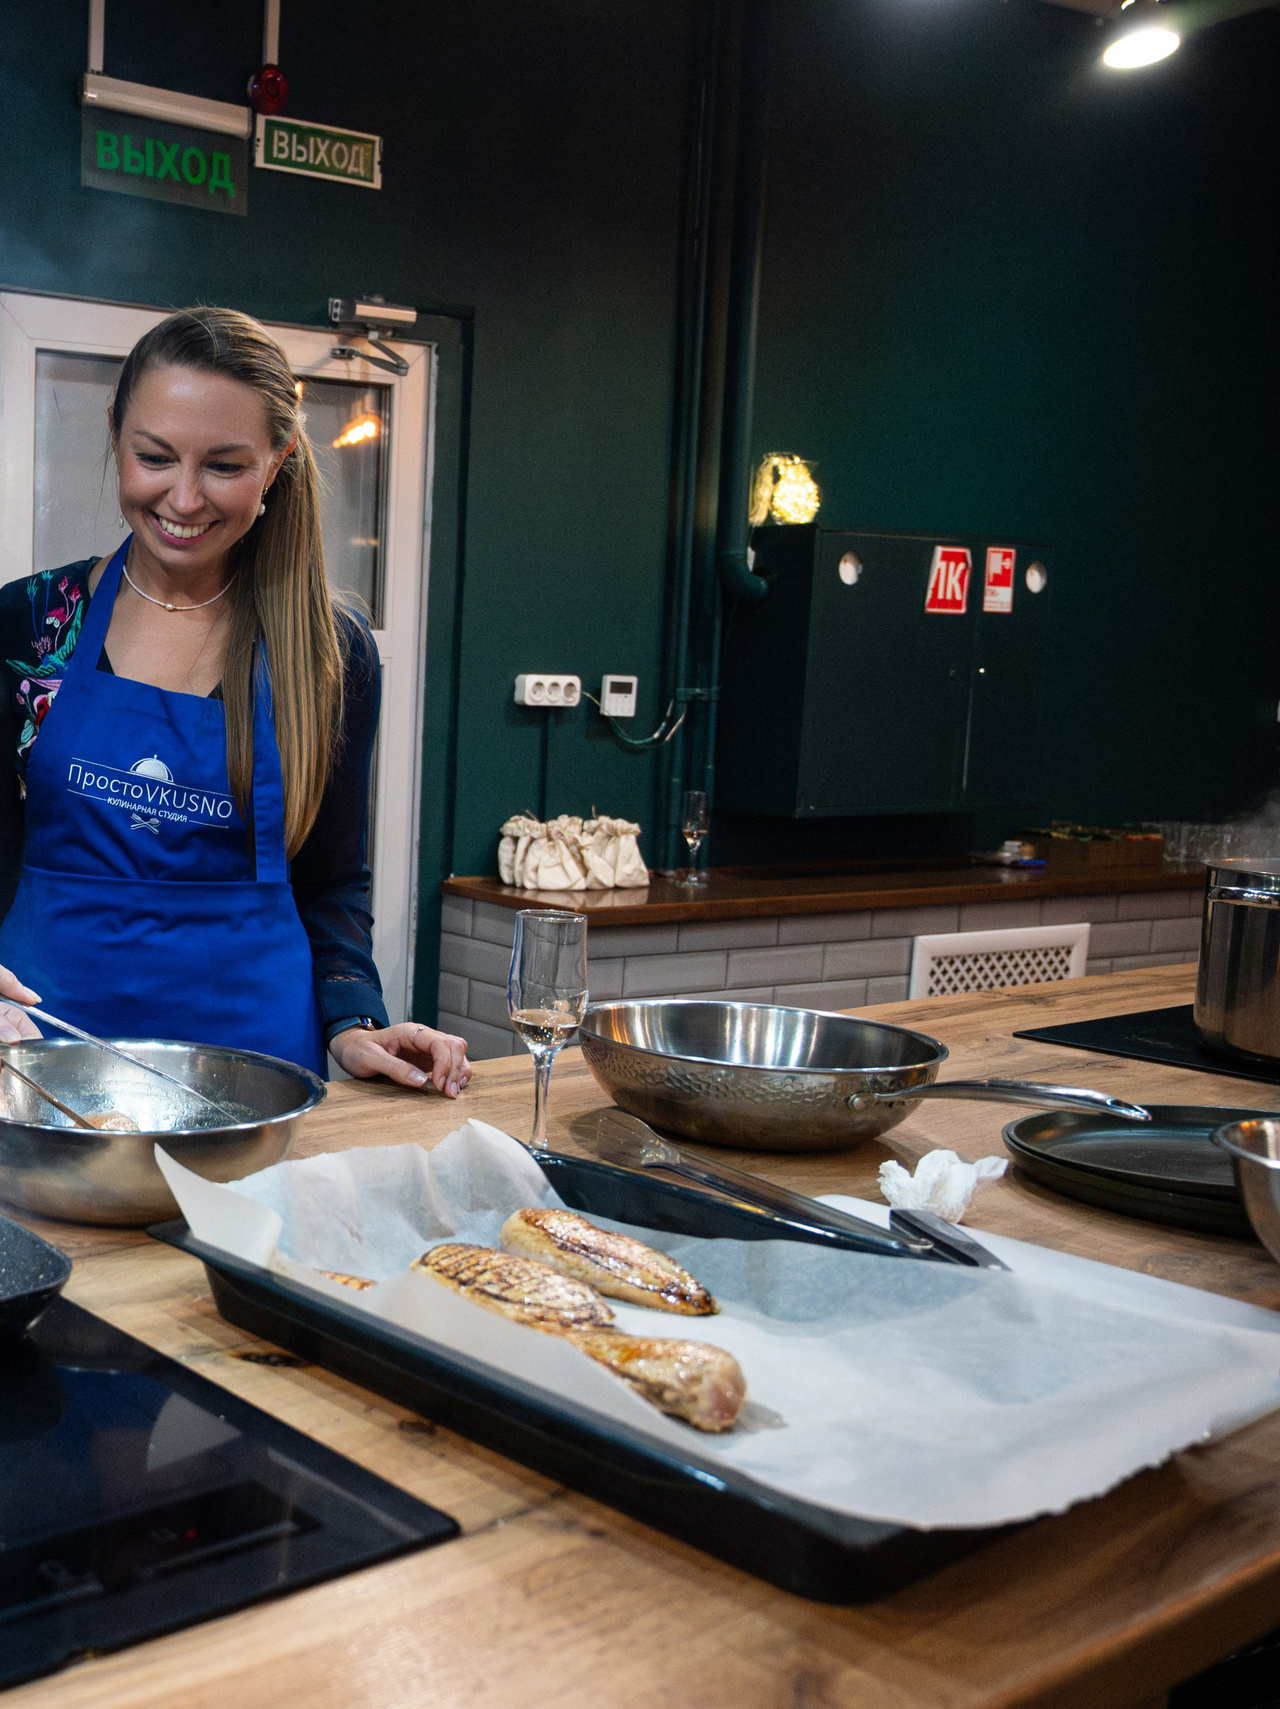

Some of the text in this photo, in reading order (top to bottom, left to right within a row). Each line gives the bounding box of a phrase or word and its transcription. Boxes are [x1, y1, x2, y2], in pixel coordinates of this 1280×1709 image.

[96, 130, 235, 198] ВЫХОД
[273, 129, 365, 176] ВЫХОД
[107, 796, 188, 823] КУЛИНАРНАЯ СТУДИЯ
